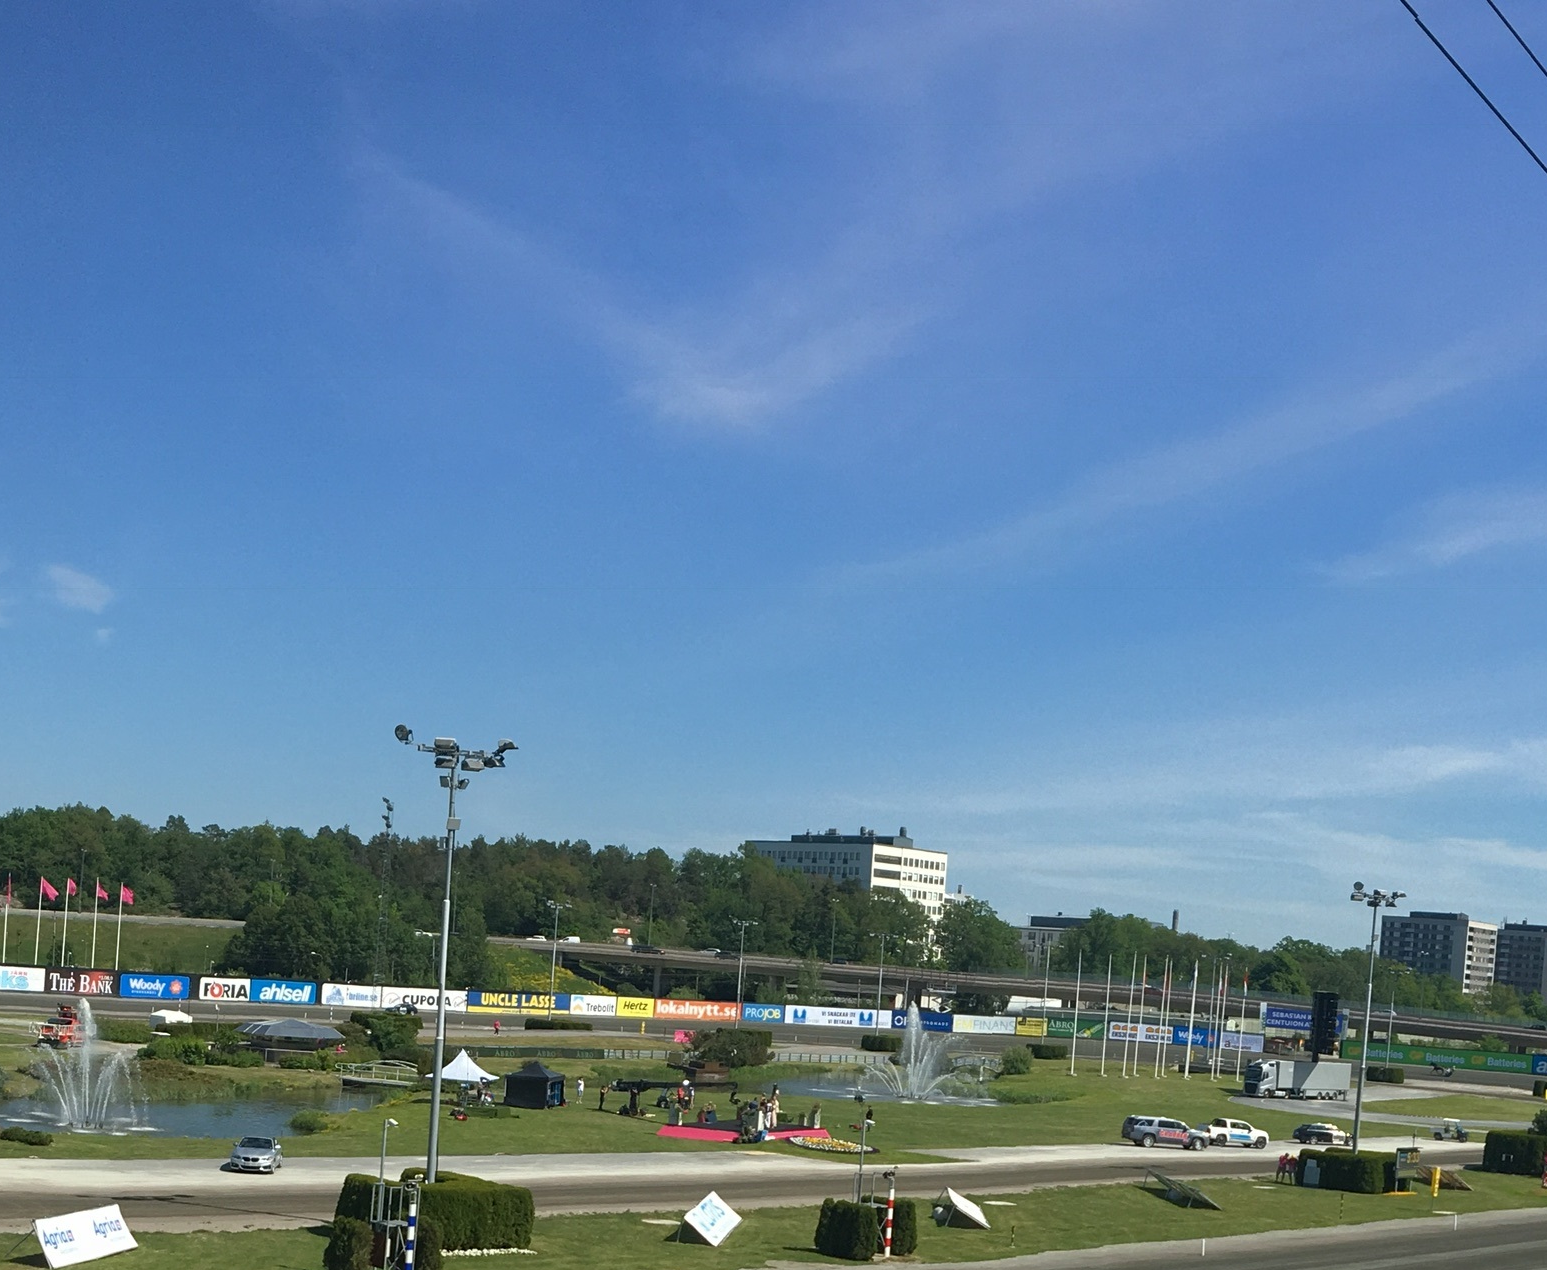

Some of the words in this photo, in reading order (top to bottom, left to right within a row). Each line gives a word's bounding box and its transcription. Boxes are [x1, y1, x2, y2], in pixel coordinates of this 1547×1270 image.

[79, 974, 113, 995] BANK
[129, 978, 165, 997] Woody
[203, 982, 248, 999] FORIA
[260, 983, 311, 1002] ahlsell
[481, 993, 518, 1007] UNCLE
[586, 1003, 614, 1013] Trebolit
[623, 1000, 649, 1011] Hertz
[656, 1001, 738, 1018] lokalnytt.se
[745, 1007, 781, 1019] PROJOB
[1366, 1048, 1403, 1060] Batteries
[1426, 1052, 1465, 1064] Batteries
[1487, 1057, 1527, 1069] Batteries
[93, 1216, 116, 1239] Agria
[43, 1226, 67, 1250] Agria
